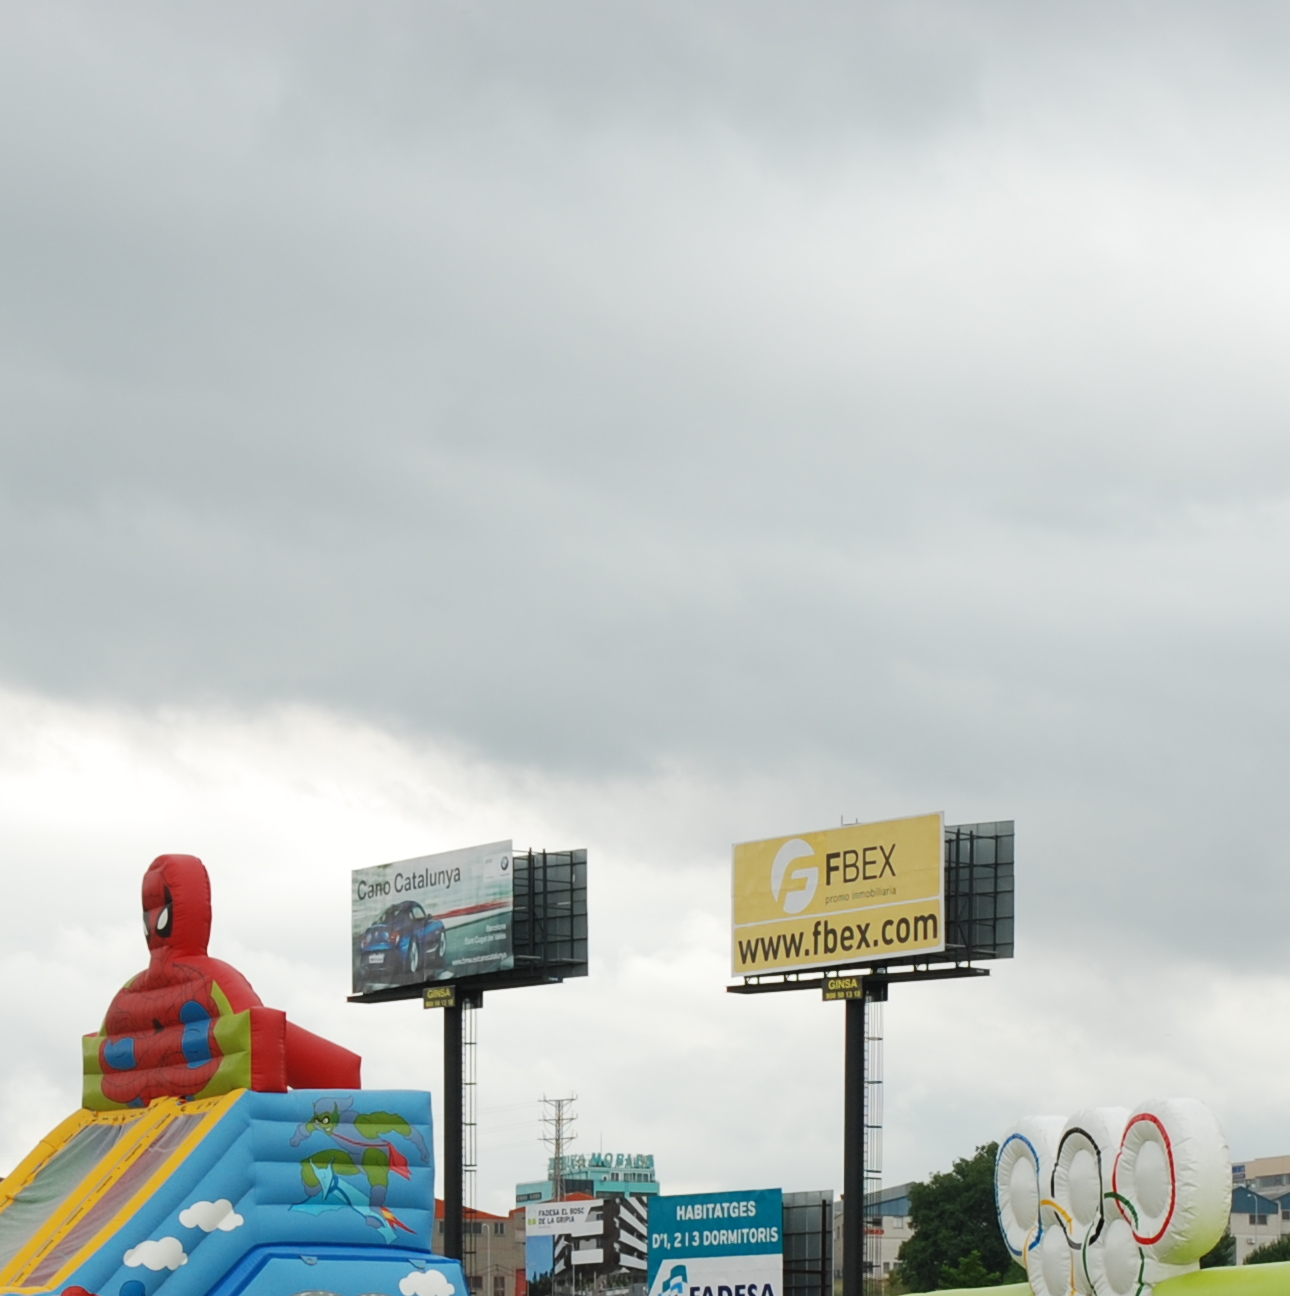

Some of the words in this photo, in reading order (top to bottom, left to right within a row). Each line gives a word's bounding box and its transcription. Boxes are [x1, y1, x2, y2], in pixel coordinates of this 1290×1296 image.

[826, 844, 896, 886] FBEX
[358, 880, 390, 900] Cano
[394, 866, 461, 893] Catalunya
[825, 893, 849, 904] promo
[738, 912, 938, 965] www.fbex.com
[828, 978, 858, 990] GINSA
[676, 1201, 756, 1220] HABITATGES
[674, 1232, 682, 1247] 2
[692, 1231, 700, 1246] 3
[703, 1227, 778, 1246] DORMITORIS
